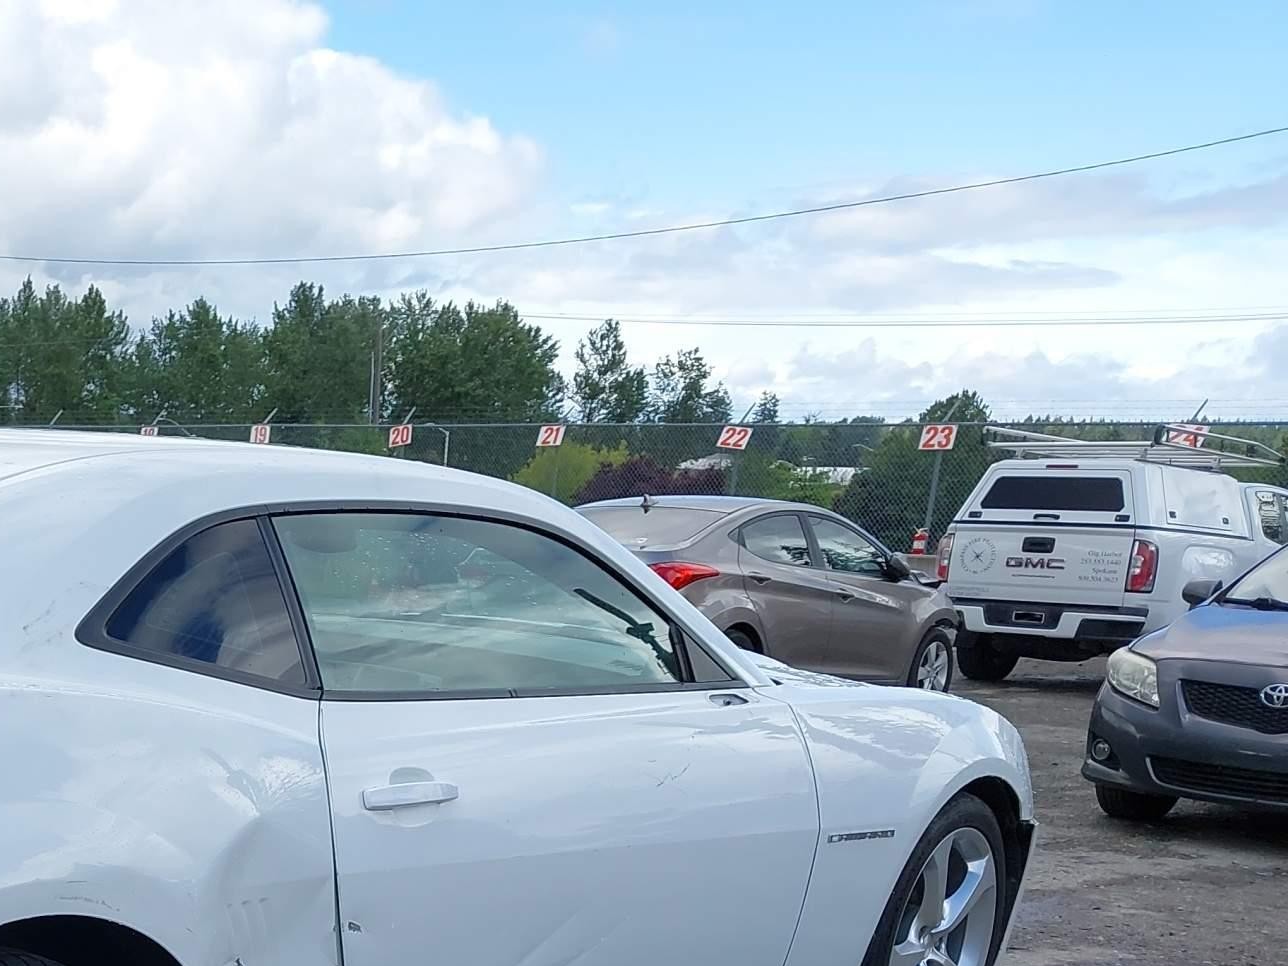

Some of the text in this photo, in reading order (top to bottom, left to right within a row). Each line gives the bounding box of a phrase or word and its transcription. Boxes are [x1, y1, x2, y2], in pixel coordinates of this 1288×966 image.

[254, 424, 267, 444] 19
[391, 426, 410, 445] 20
[541, 427, 560, 445] 21
[720, 427, 749, 448] 22
[922, 426, 953, 449] 23
[1005, 557, 1065, 570] GMC
